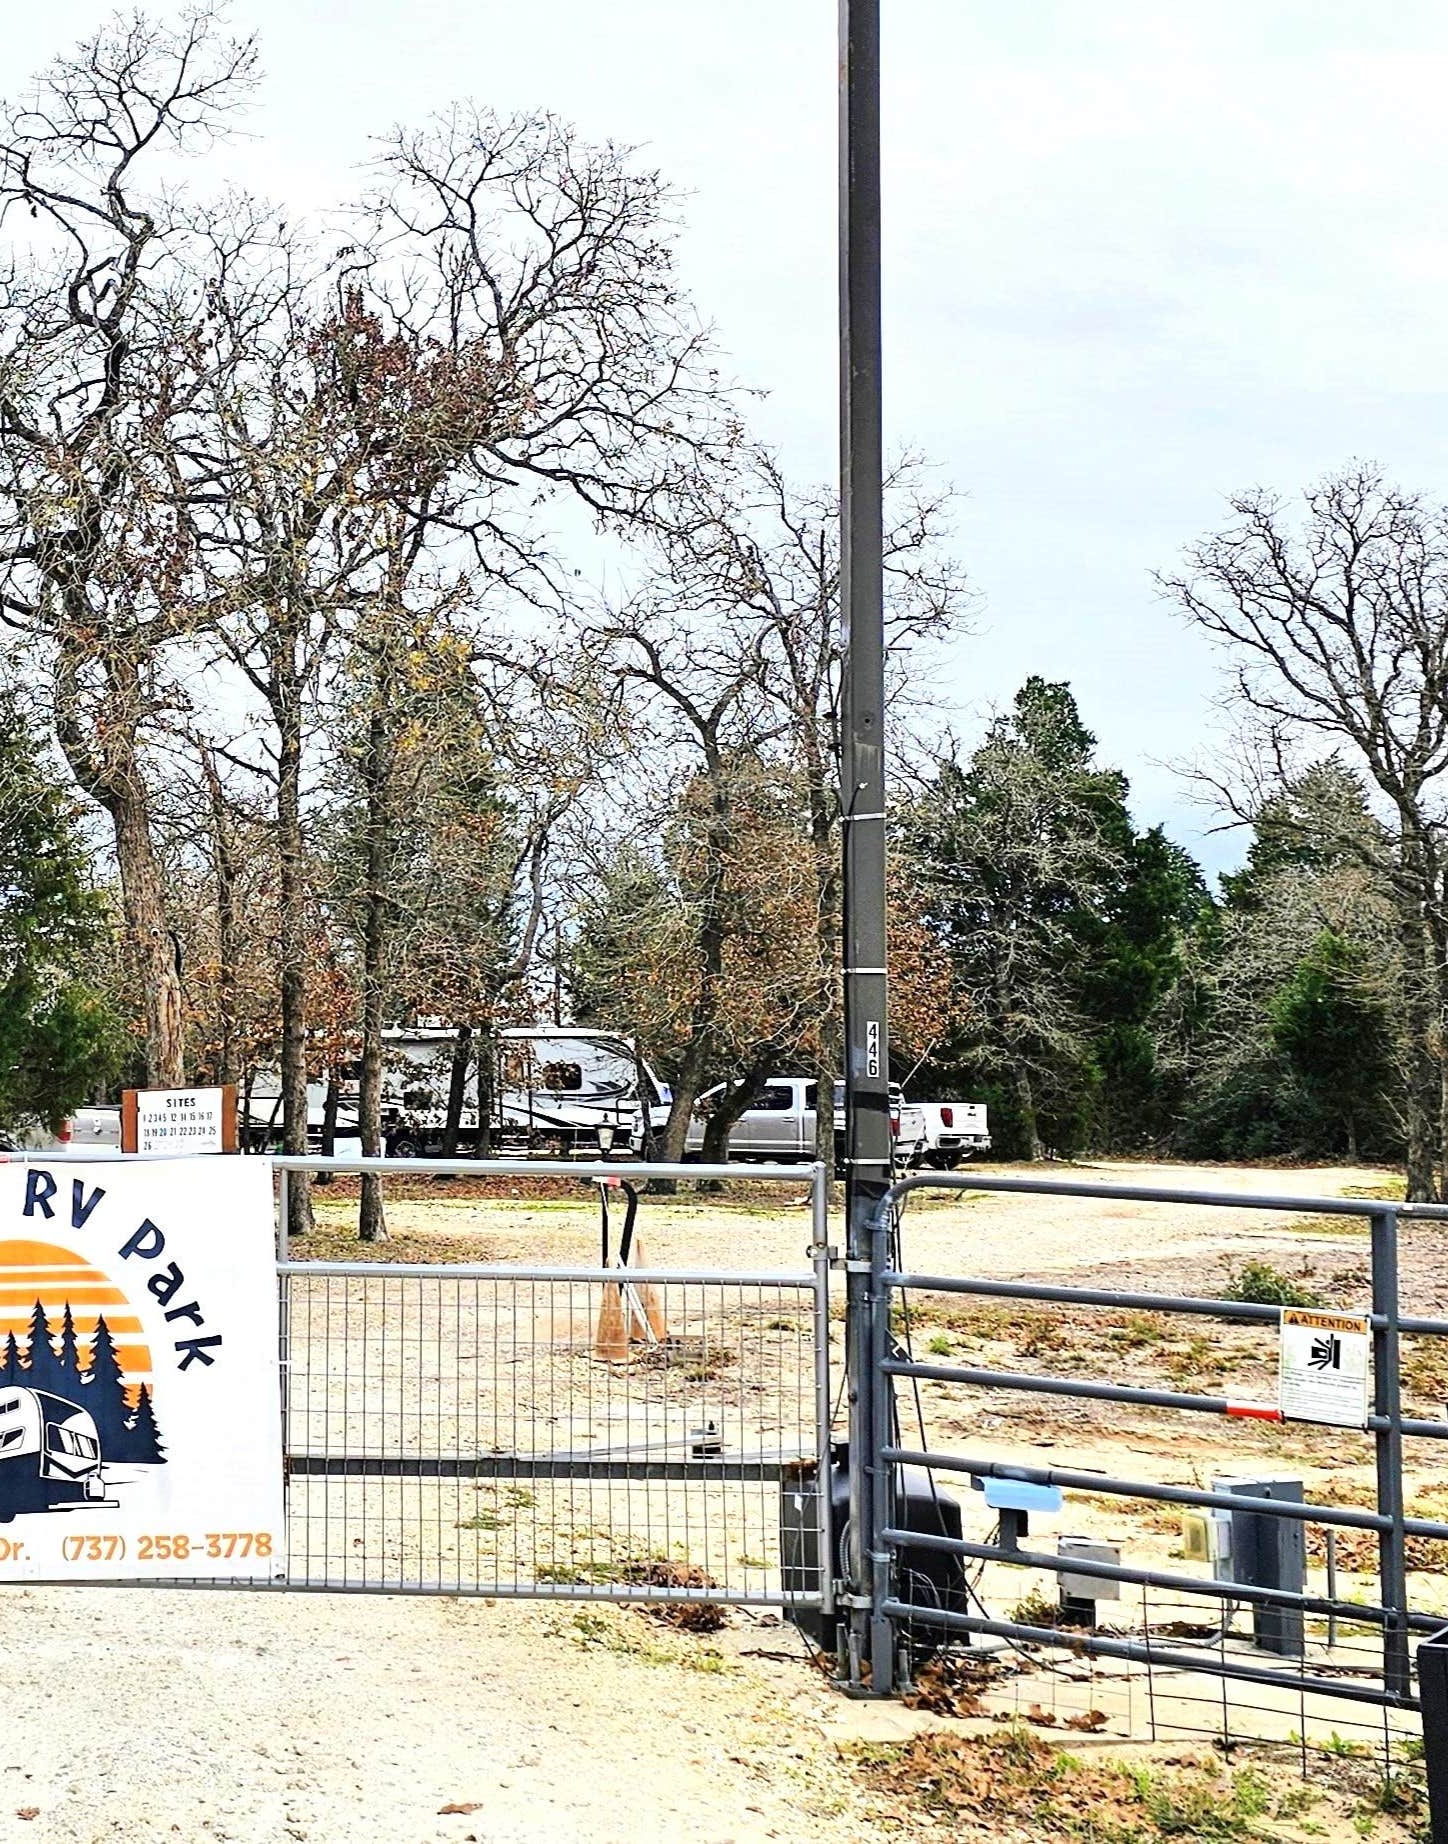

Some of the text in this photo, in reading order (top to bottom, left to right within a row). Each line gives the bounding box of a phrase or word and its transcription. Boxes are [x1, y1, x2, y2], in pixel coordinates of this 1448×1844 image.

[868, 1023, 878, 1076] 446
[166, 1097, 196, 1108] SITES
[170, 1112, 177, 1122] 12
[189, 1111, 196, 1121] 15
[179, 1126, 187, 1136] 22
[188, 1126, 197, 1136] 23
[198, 1126, 206, 1136] 24
[208, 1125, 217, 1135] 25
[22, 1168, 106, 1230] RV
[118, 1217, 223, 1372] Park
[1301, 1314, 1361, 1332] ATTENTION
[62, 1535, 126, 1561] (737)
[137, 1532, 273, 1561] 258-3778
